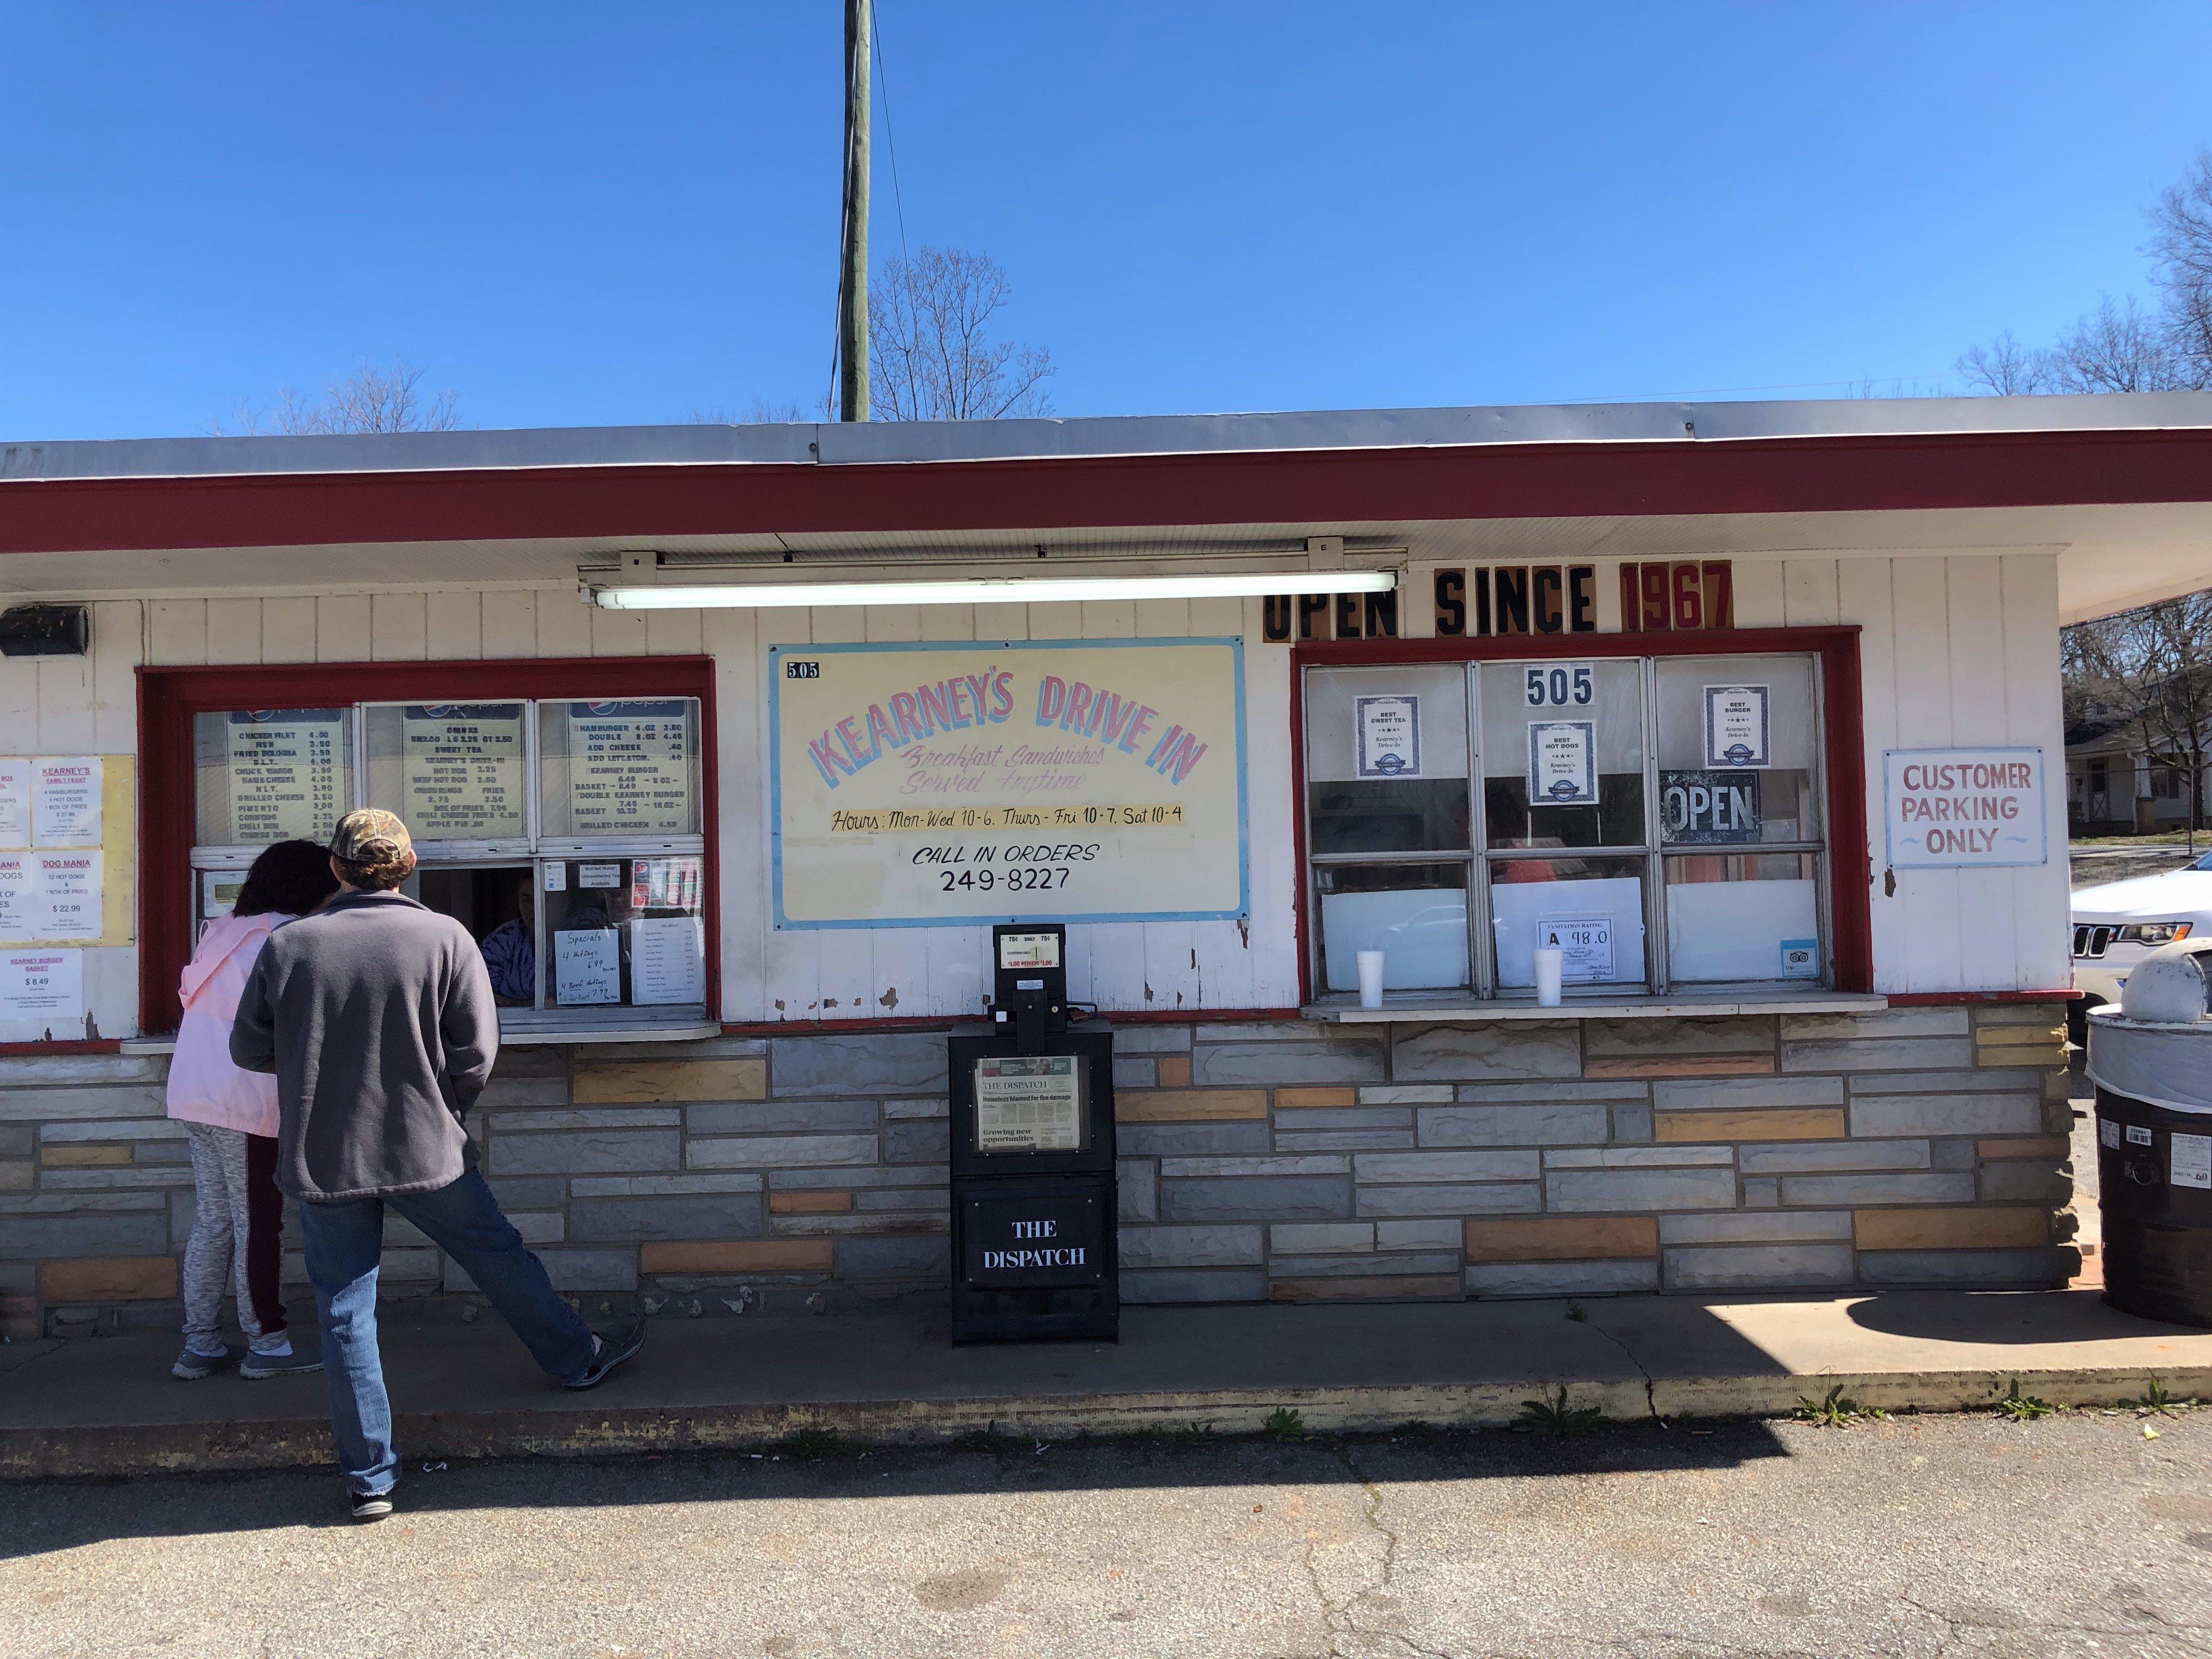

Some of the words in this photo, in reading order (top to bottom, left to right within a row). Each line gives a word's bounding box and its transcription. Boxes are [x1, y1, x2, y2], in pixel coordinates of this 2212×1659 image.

[1265, 593, 1398, 641] OPEN
[1436, 567, 1595, 636] SINCE
[1621, 565, 1732, 632] 1967
[788, 663, 818, 678] 505
[1528, 669, 1592, 705] 505
[808, 664, 1014, 788] KEARNEY'S
[1036, 676, 1159, 755] DRIVE
[1145, 725, 1208, 785] IN
[899, 744, 1003, 773] Breakfast
[1005, 744, 1105, 768] Sandwiches
[899, 770, 986, 794] Served
[1903, 763, 2032, 791] CUSTOMER
[1002, 808, 1040, 826] Thurs
[1054, 808, 1076, 825] Fri
[1152, 806, 1181, 823] 10-4
[1664, 786, 1754, 832] OPEN
[1901, 796, 2019, 822] PARKING
[1926, 828, 2000, 854] ONLY
[912, 846, 966, 865] CALL
[973, 846, 997, 863] IN
[1005, 844, 1101, 861] ORDERS
[940, 868, 1070, 891] 249-8227
[568, 931, 601, 945] Specials
[1549, 933, 1560, 945] A
[563, 952, 569, 961] 4
[1004, 1081, 1047, 1089] DISPATCH
[1012, 1221, 1057, 1239] THE
[983, 1248, 1086, 1268] DISPATCH
